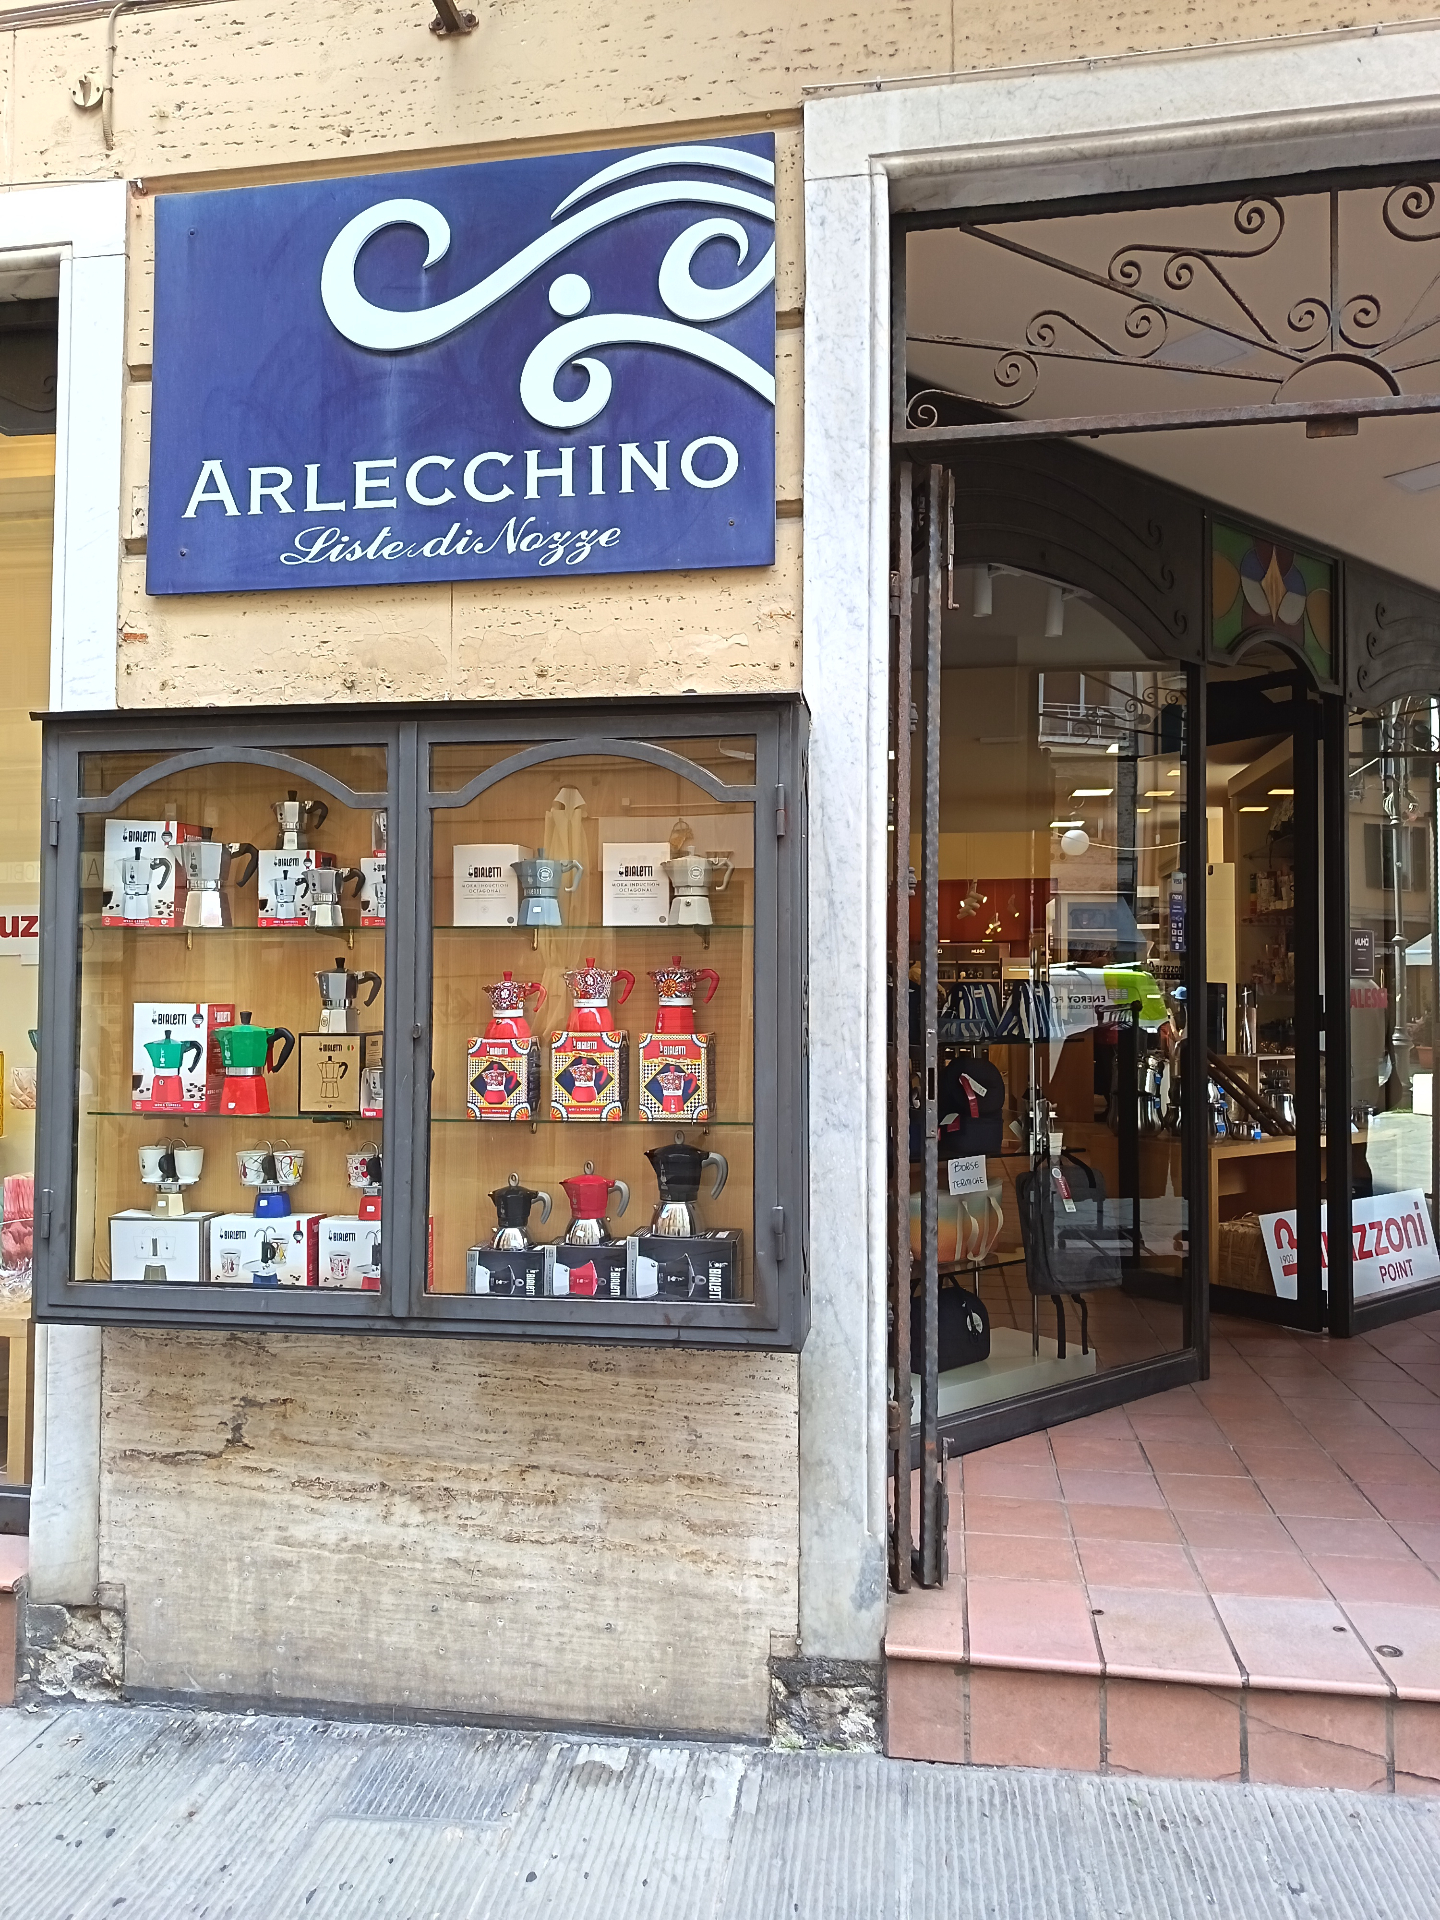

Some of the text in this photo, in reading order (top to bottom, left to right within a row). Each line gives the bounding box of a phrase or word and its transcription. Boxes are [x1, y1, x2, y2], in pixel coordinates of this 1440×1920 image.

[181, 435, 739, 519] ARLECCHINO
[279, 516, 621, 566] Liste di Nozze
[128, 831, 156, 842] BIALETTI
[473, 867, 502, 878] BIALETTI
[624, 866, 653, 877] BIALETTI
[158, 1014, 187, 1025] BIALETTI
[951, 1161, 979, 1173] BORSE
[1279, 1253, 1295, 1265] 1903
[1379, 1259, 1414, 1284] POINT
[526, 1273, 536, 1295] BIALETT
[709, 1268, 721, 1300] BIALETT
